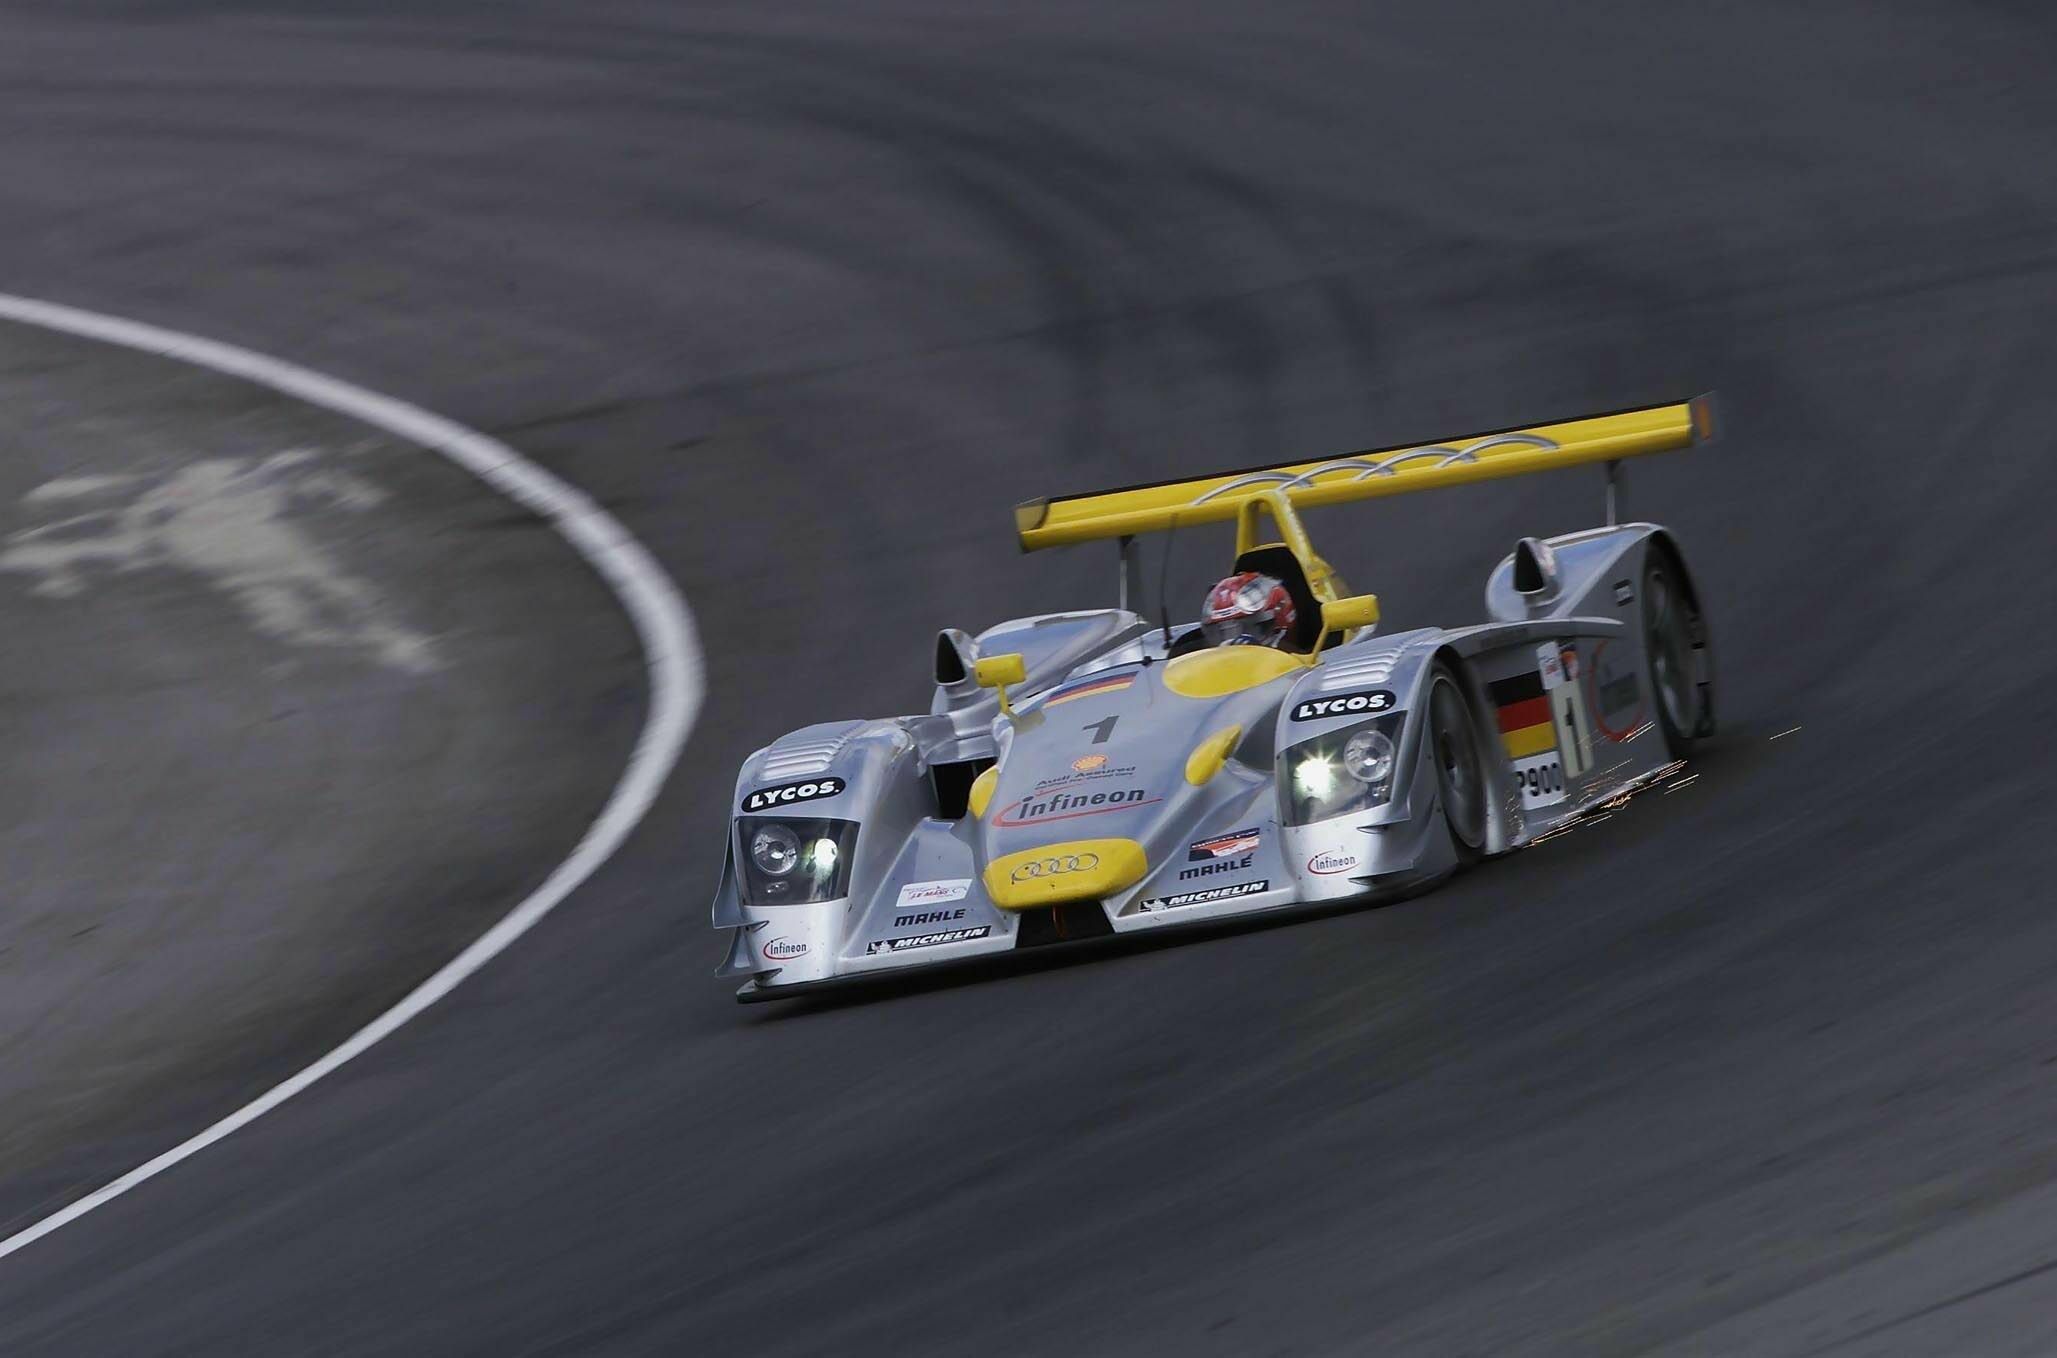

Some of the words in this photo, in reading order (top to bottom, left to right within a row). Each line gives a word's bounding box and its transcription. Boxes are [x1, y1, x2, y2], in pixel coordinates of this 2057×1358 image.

[1299, 694, 1385, 718] LYCOS
[1082, 715, 1120, 745] 1
[750, 780, 837, 809] LYCOS
[1179, 859, 1253, 880] MAHLE
[1168, 881, 1265, 905] MICHELIN
[894, 908, 966, 927] MAHLE
[895, 927, 986, 948] MICHELIN
